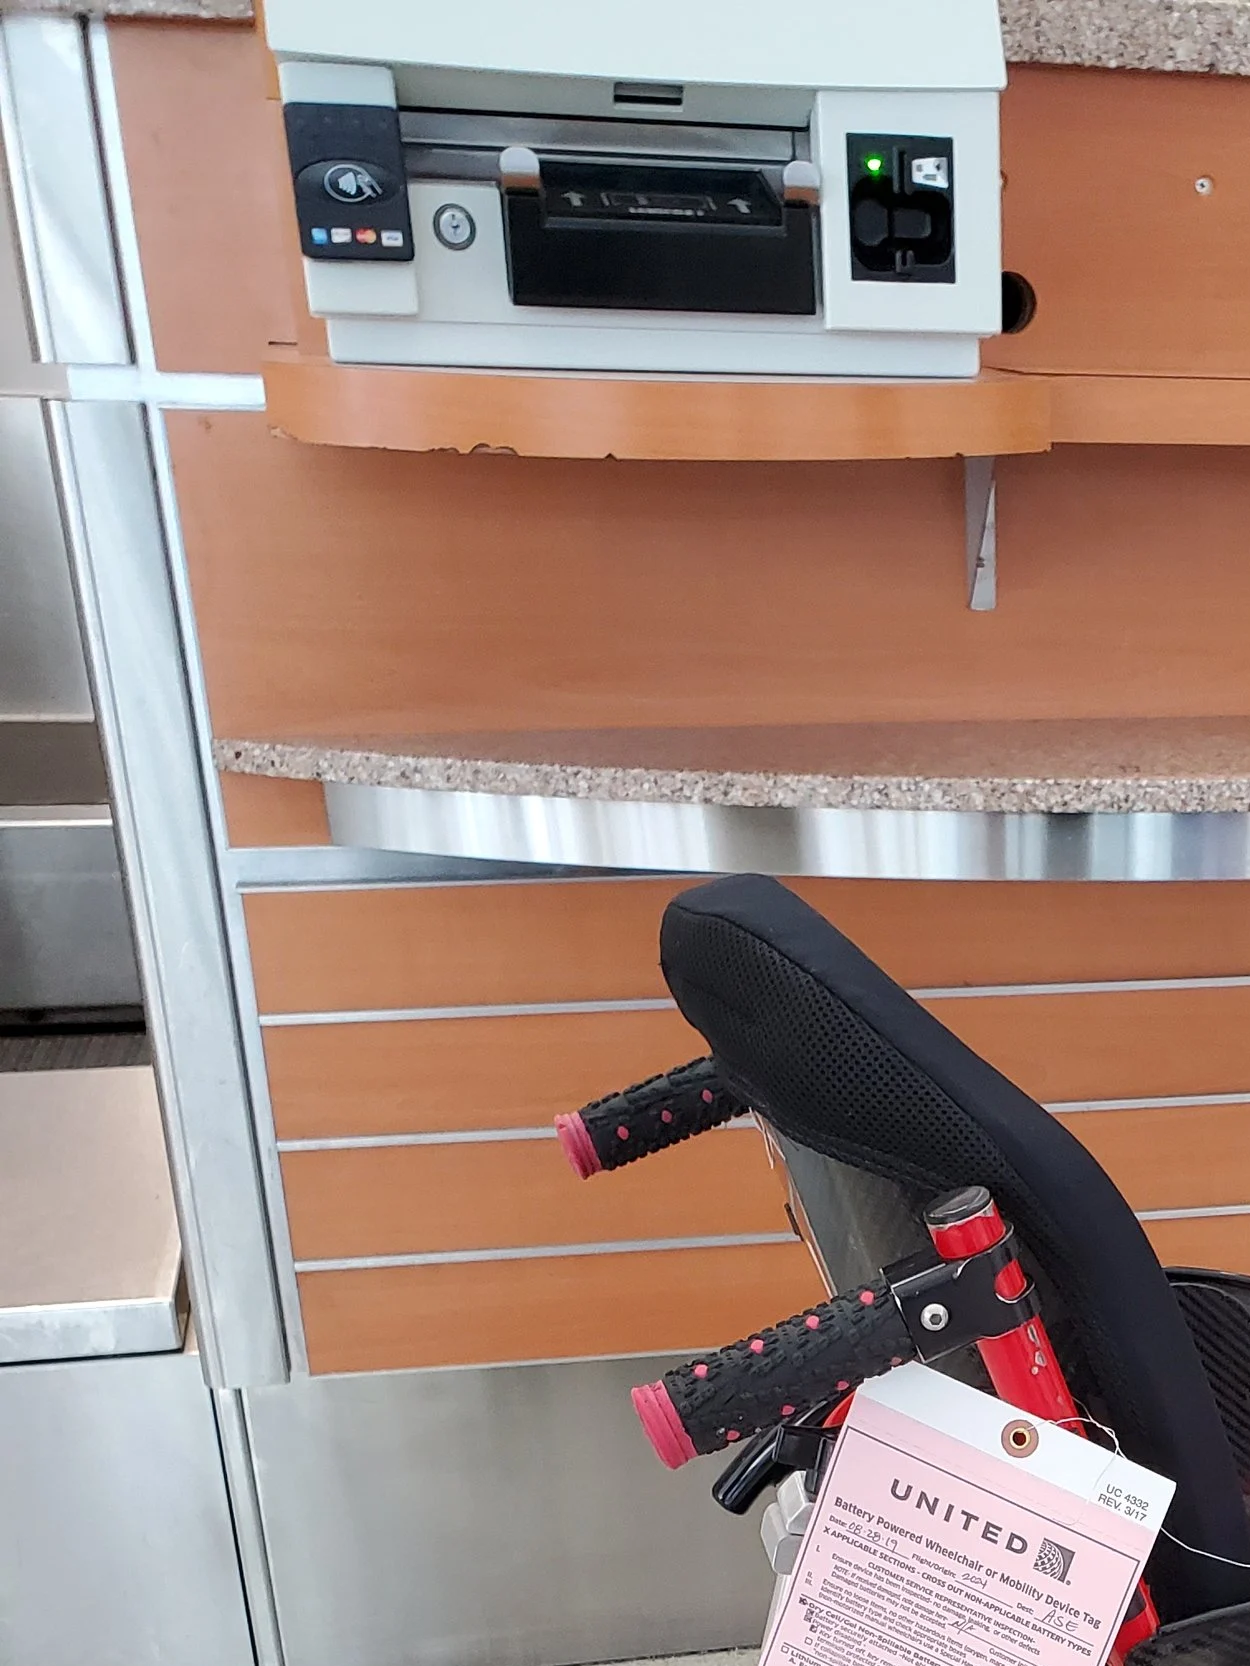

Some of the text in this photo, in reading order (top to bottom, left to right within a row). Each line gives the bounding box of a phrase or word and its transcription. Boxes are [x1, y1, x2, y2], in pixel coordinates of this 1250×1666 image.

[890, 1478, 1028, 1554] UNITED
[1098, 1494, 1148, 1522] REV. 3/17
[1106, 1484, 1149, 1512] UC 4332
[822, 1525, 1092, 1657] X APPLICABLE SECTIONS CROSS OUT NON-APPLICABLE BATTERY TYPES
[828, 1514, 848, 1528] Date:
[1016, 1602, 1034, 1615] Dest:
[1042, 1608, 1079, 1632] ASE
[831, 1552, 853, 1568] Ensure
[852, 1563, 873, 1577] device
[873, 1572, 885, 1582] has
[884, 1577, 901, 1590] been
[901, 1585, 932, 1604] inspected-
[932, 1601, 942, 1609] no
[941, 1605, 967, 1623] damage,
[966, 1616, 990, 1633] leaking,
[1000, 1633, 1018, 1644] other
[1018, 1641, 1041, 1656] defects
[834, 1496, 1102, 1630] Battery Powered Wheelchair or Mobility Device Tag
[867, 1561, 1036, 1643] CUSTOMER SERVICE REPRESENTATIVE INSPECTION-
[807, 1602, 825, 1614] Dry
[824, 1610, 858, 1629] Cell/Gel
[857, 1625, 912, 1655] Non-Spillable
